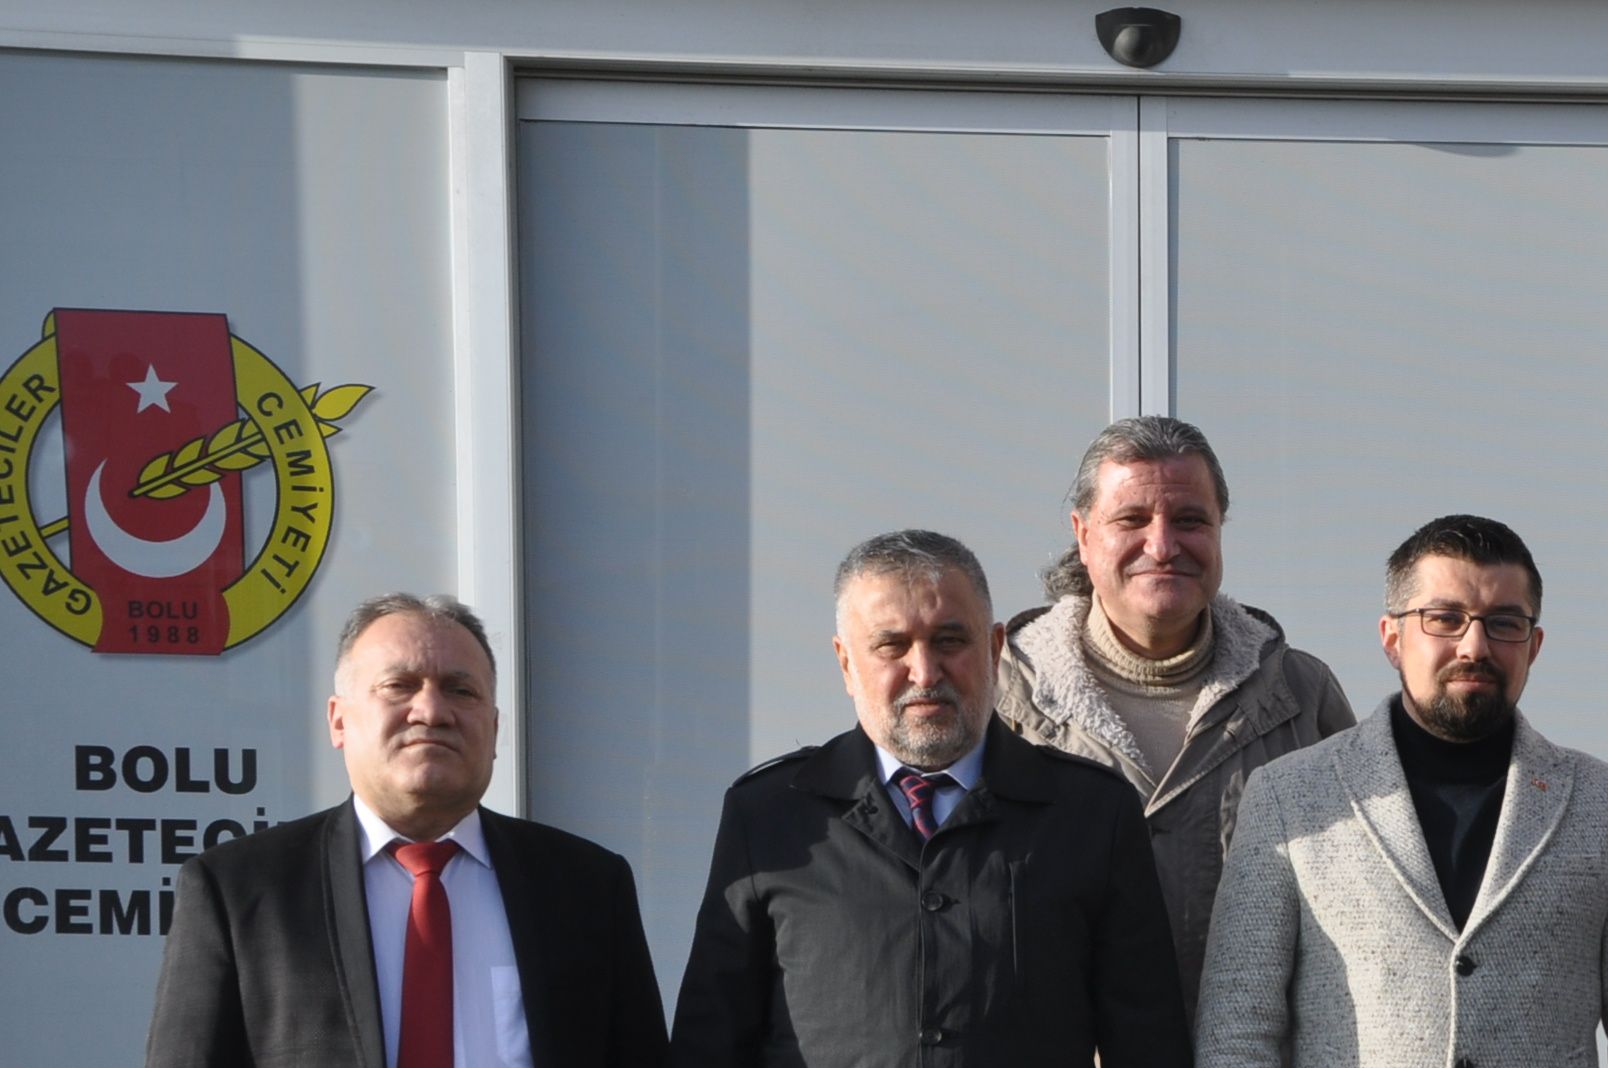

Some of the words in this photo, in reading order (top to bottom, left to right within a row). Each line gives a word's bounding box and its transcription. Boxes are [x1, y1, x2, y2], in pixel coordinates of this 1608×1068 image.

[257, 392, 324, 595] CEMİYETİ
[128, 601, 198, 620] BOLU
[130, 625, 199, 644] 1988
[75, 744, 257, 795] BOLU
[3, 877, 174, 936] CEMİ
